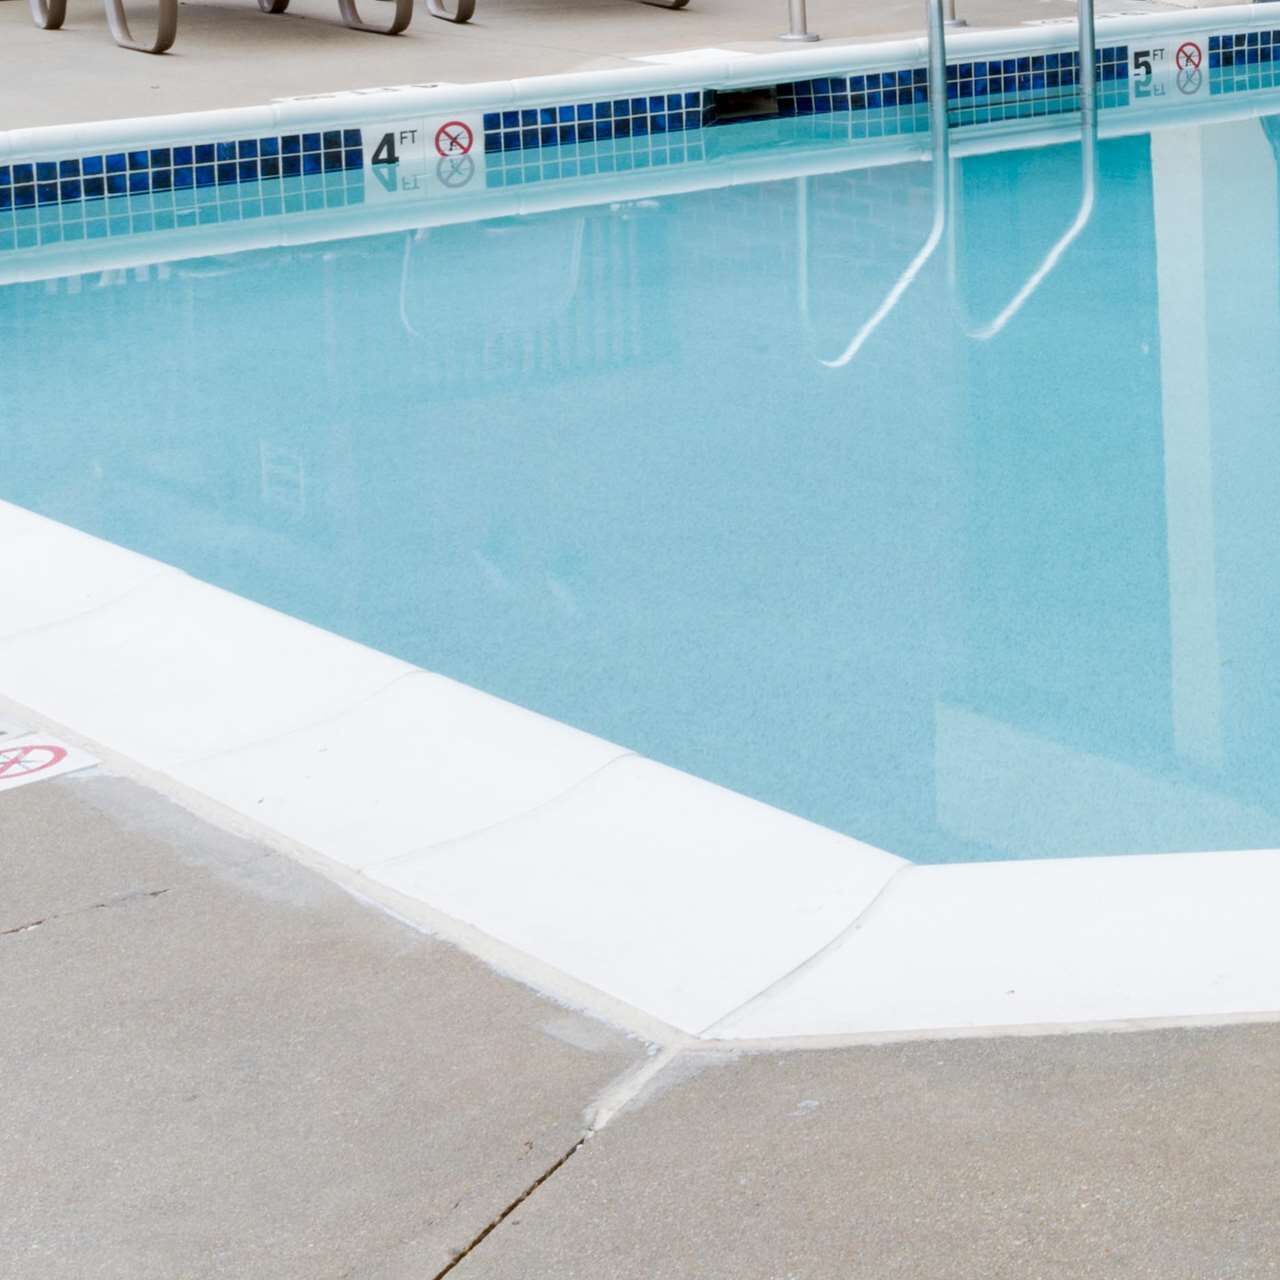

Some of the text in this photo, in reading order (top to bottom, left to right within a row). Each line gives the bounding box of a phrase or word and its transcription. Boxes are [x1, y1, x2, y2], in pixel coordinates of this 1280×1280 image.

[1133, 48, 1165, 76] 5 FT
[371, 130, 417, 165] 4 FT
